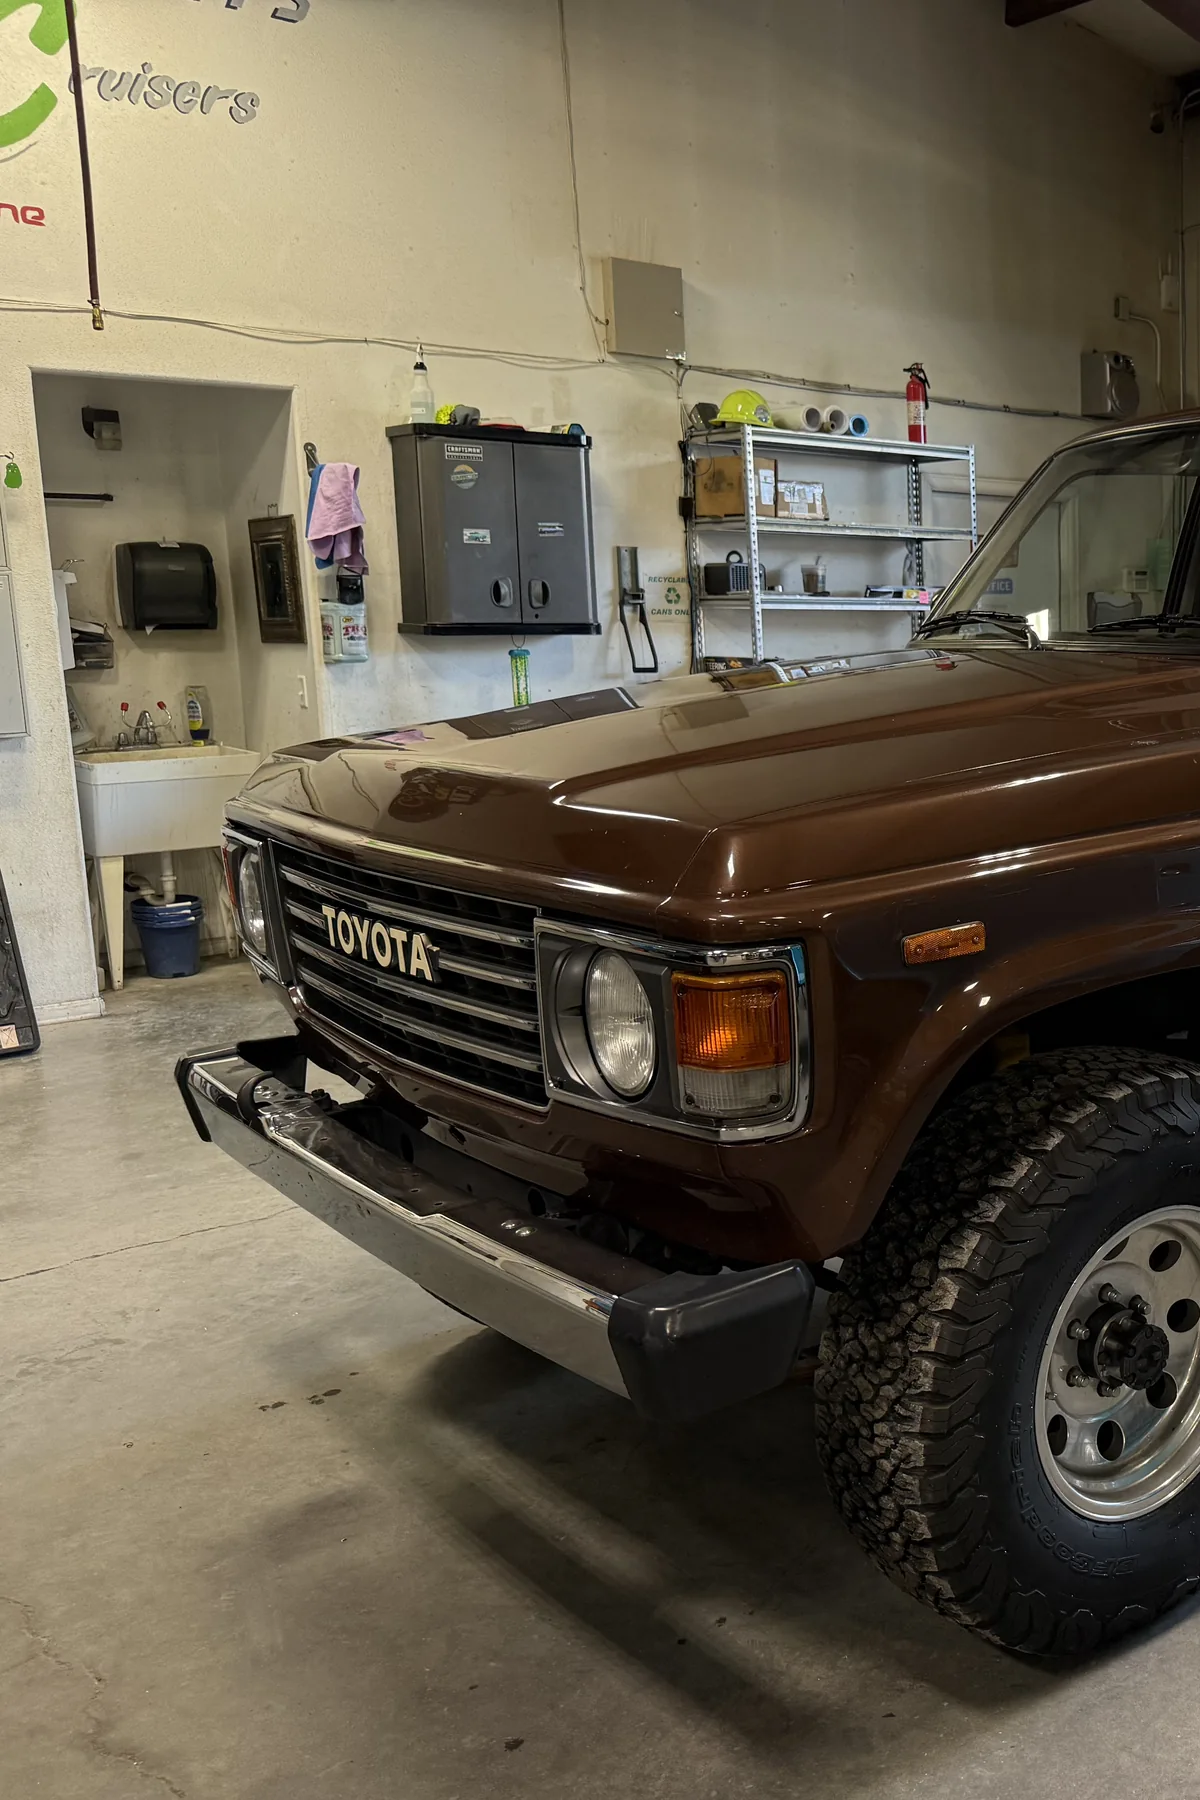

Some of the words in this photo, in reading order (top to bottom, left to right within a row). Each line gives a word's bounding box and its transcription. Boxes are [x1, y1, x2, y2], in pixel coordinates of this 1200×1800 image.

[447, 446, 481, 454] CRAFTSMAN
[986, 581, 1011, 591] FICE
[706, 662, 727, 670] TEERING
[321, 904, 434, 982] TOYOTA
